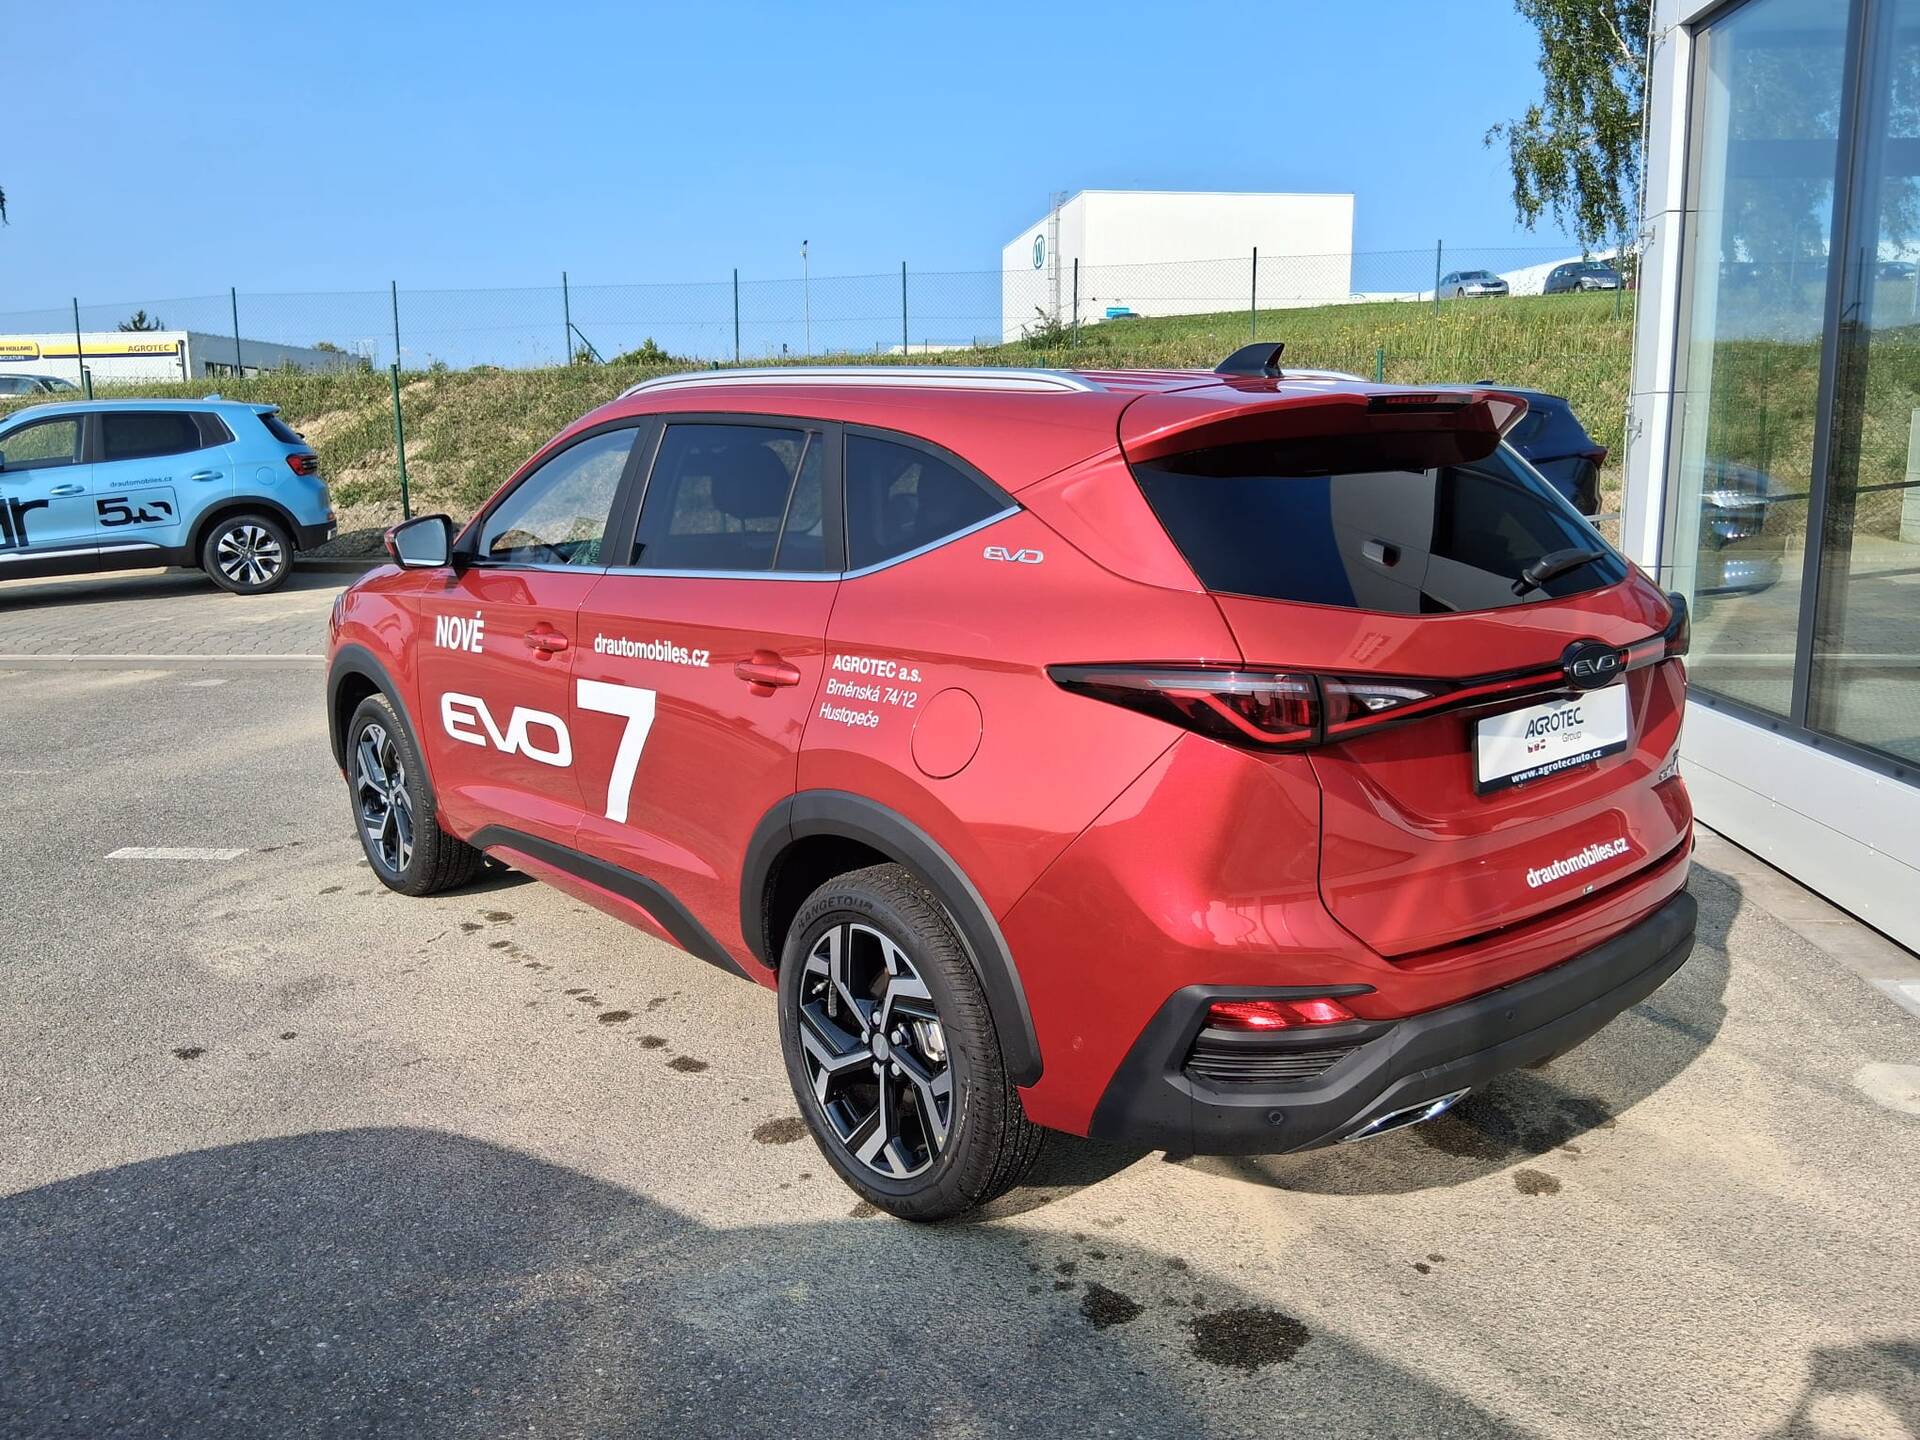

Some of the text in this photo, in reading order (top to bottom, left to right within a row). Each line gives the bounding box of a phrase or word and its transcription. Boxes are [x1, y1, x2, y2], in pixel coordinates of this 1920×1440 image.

[127, 344, 170, 352] AGROTEC
[983, 546, 1044, 564] EVO
[435, 611, 485, 653] NOVÉ
[594, 633, 710, 667] drautomobiles.cz
[1573, 654, 1616, 677] EVO
[832, 654, 922, 682] AGROTEC a.s.
[826, 678, 918, 708] Brněnská 74/12
[441, 692, 573, 767] EVO
[818, 702, 879, 728] Hustopeče
[1525, 706, 1584, 739] AGROTEC
[576, 679, 657, 824] 7
[1511, 750, 1602, 783] www.agrotecauto.cz
[1526, 837, 1630, 888] drautomobiles.cz
